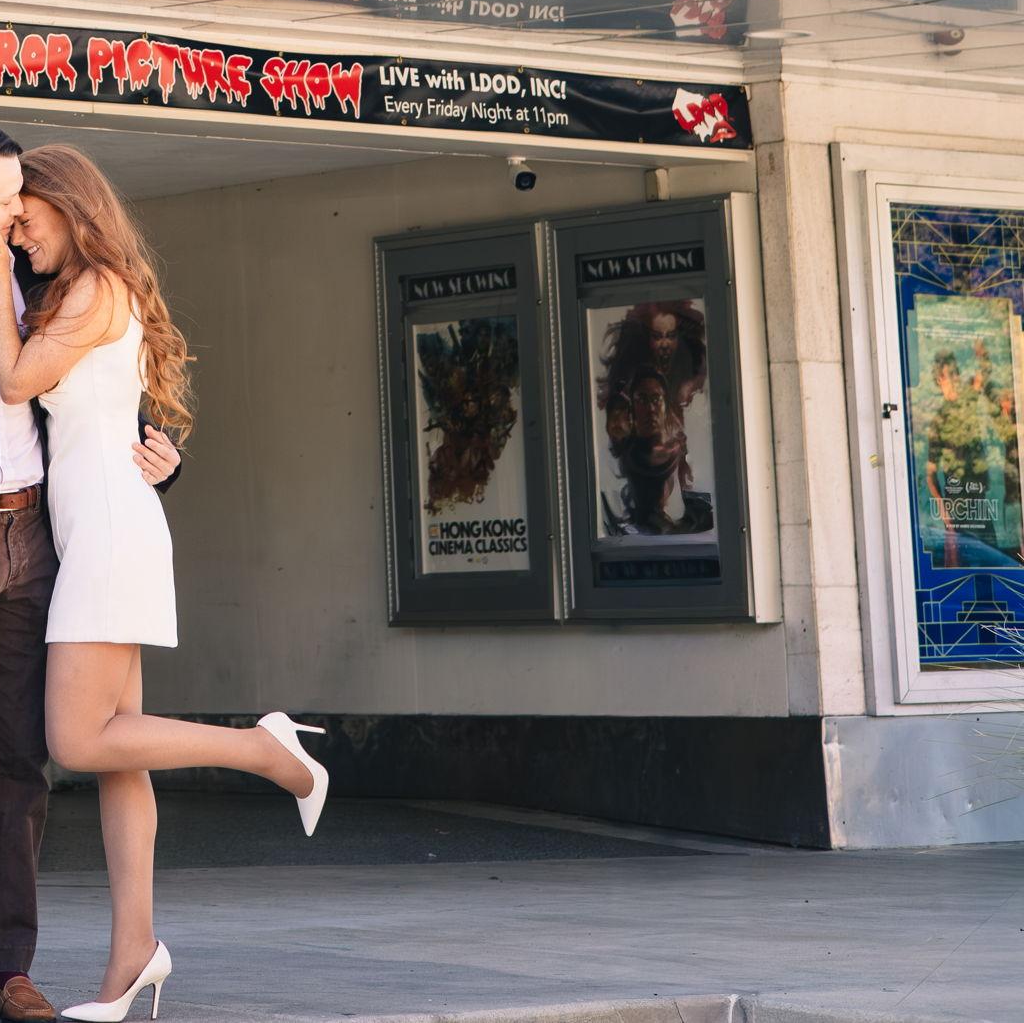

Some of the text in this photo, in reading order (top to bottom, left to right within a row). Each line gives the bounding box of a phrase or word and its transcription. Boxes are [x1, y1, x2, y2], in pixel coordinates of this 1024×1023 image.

[87, 37, 253, 108] PICTURE
[259, 55, 364, 119] SHOW
[379, 65, 567, 100] LIVE with LDOD, INC!
[384, 95, 569, 128] Every Friday Night at 11pm
[929, 497, 999, 521] URCHIN
[440, 518, 526, 539] HONG KONG
[429, 537, 528, 555] CINEMA CLASSICS
